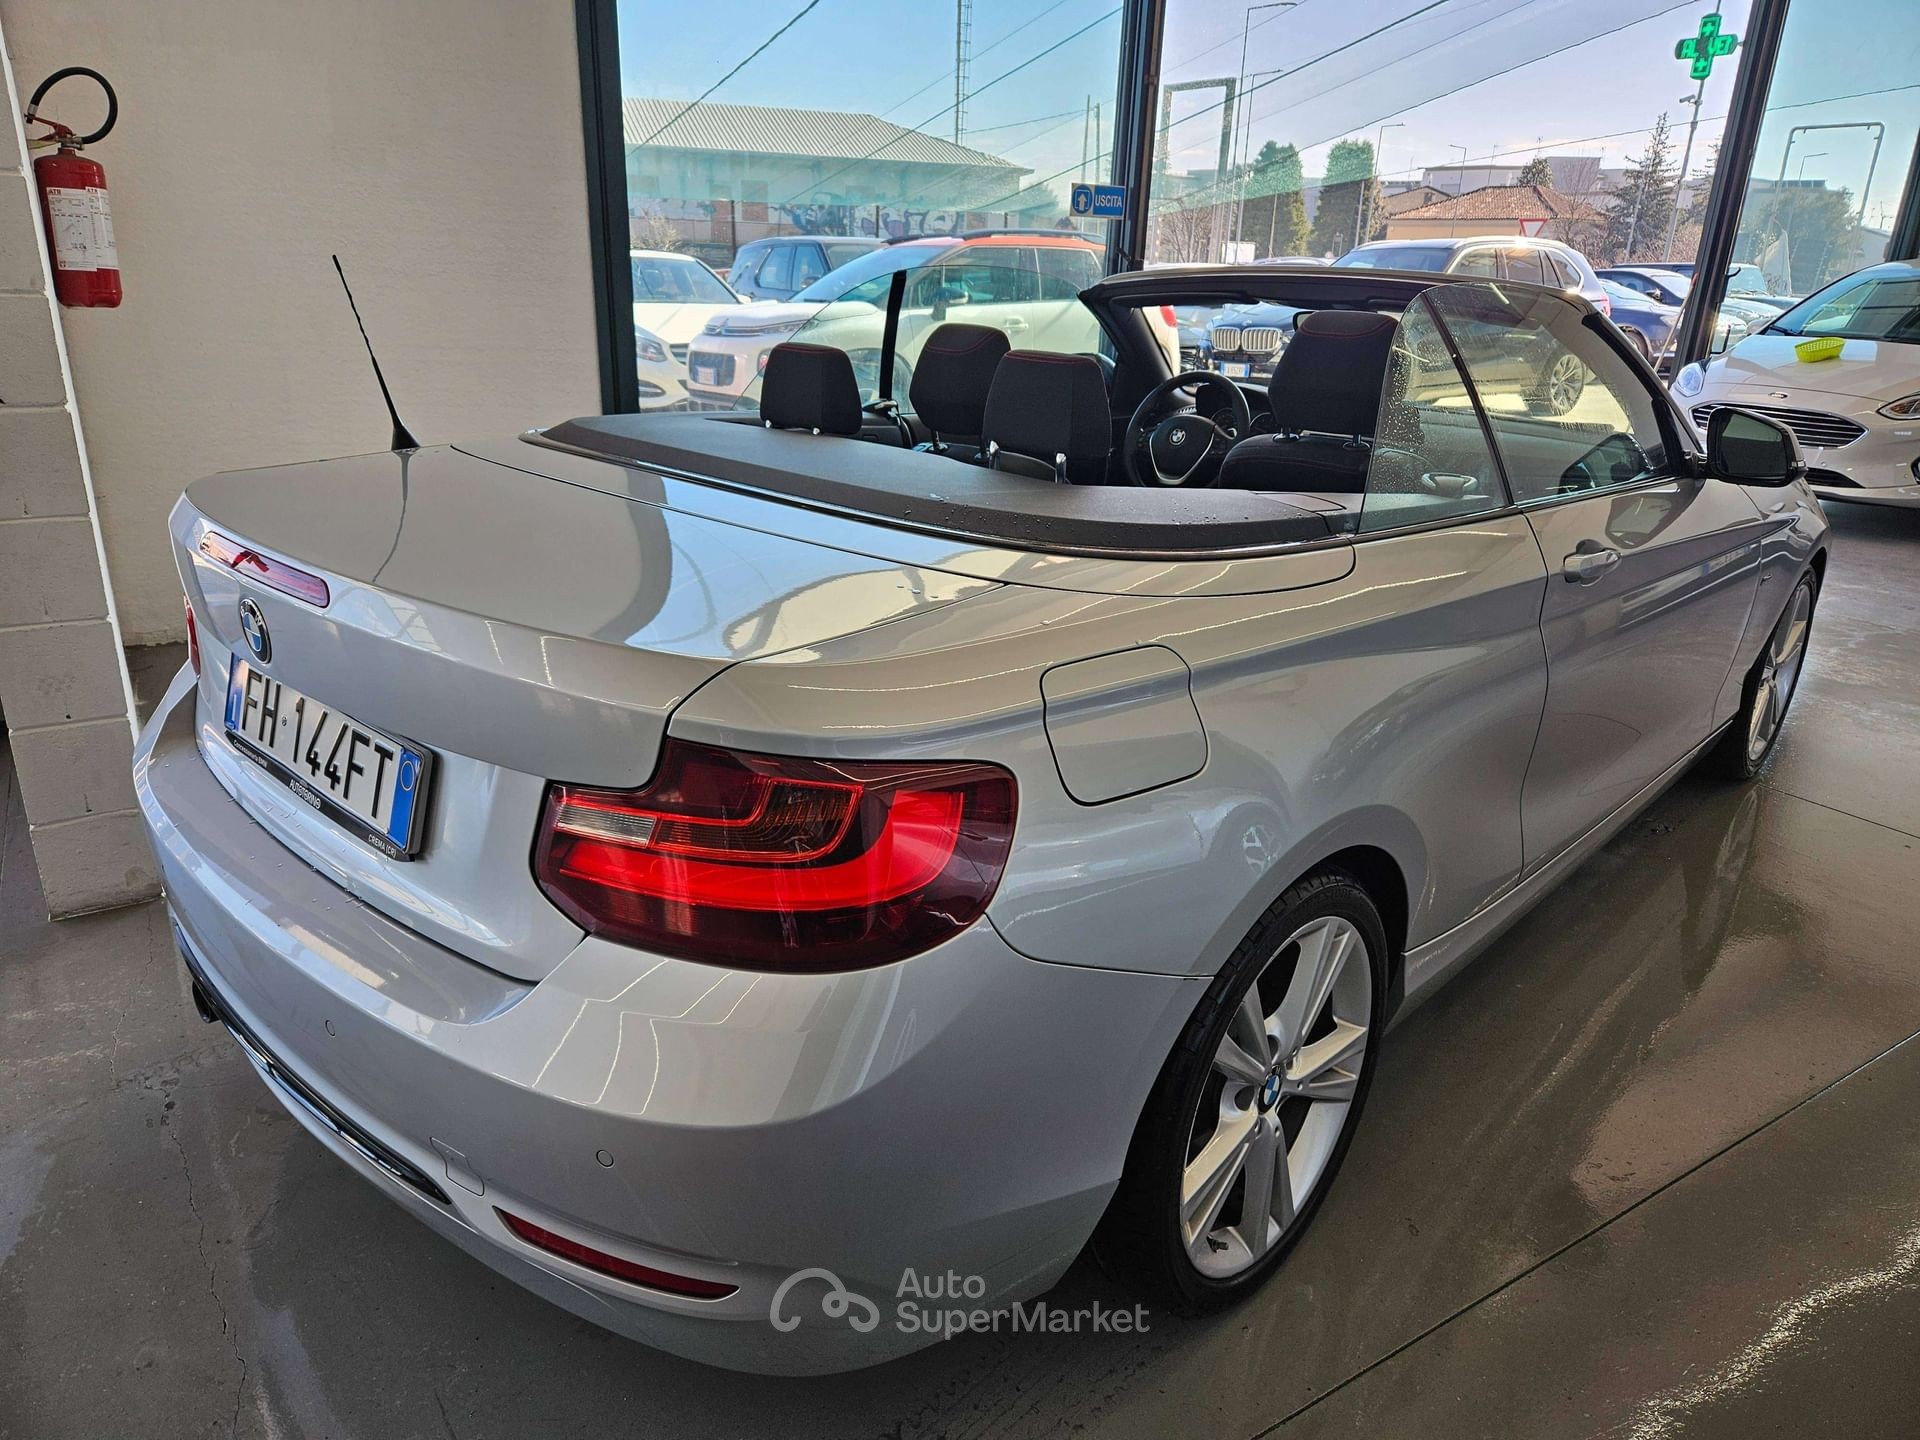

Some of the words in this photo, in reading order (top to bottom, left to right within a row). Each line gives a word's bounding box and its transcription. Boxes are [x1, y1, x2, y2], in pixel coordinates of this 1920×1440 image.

[1094, 194, 1123, 208] USCITA
[241, 668, 281, 748] FH
[293, 697, 394, 819] 144FT
[368, 833, 386, 851] CREMA
